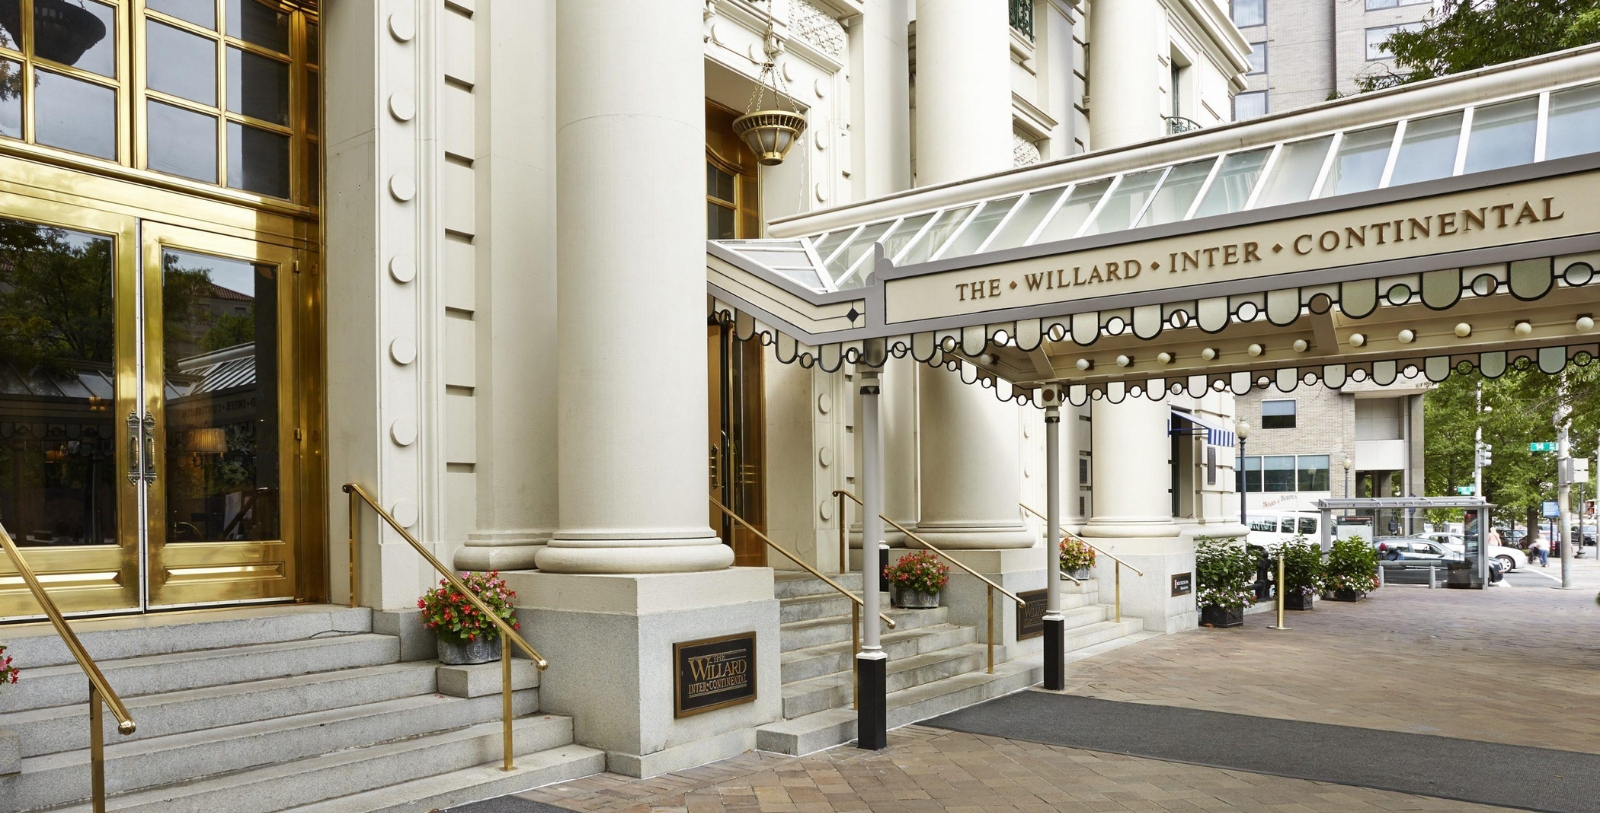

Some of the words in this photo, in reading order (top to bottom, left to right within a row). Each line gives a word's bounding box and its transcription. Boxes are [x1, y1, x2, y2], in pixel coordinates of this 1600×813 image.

[955, 278, 1001, 301] THE
[1024, 259, 1142, 292] WILLARD
[1169, 241, 1262, 273] INTER
[1293, 196, 1565, 255] CONTINENTAL
[688, 657, 747, 682] WILLARD
[712, 653, 726, 663] THE
